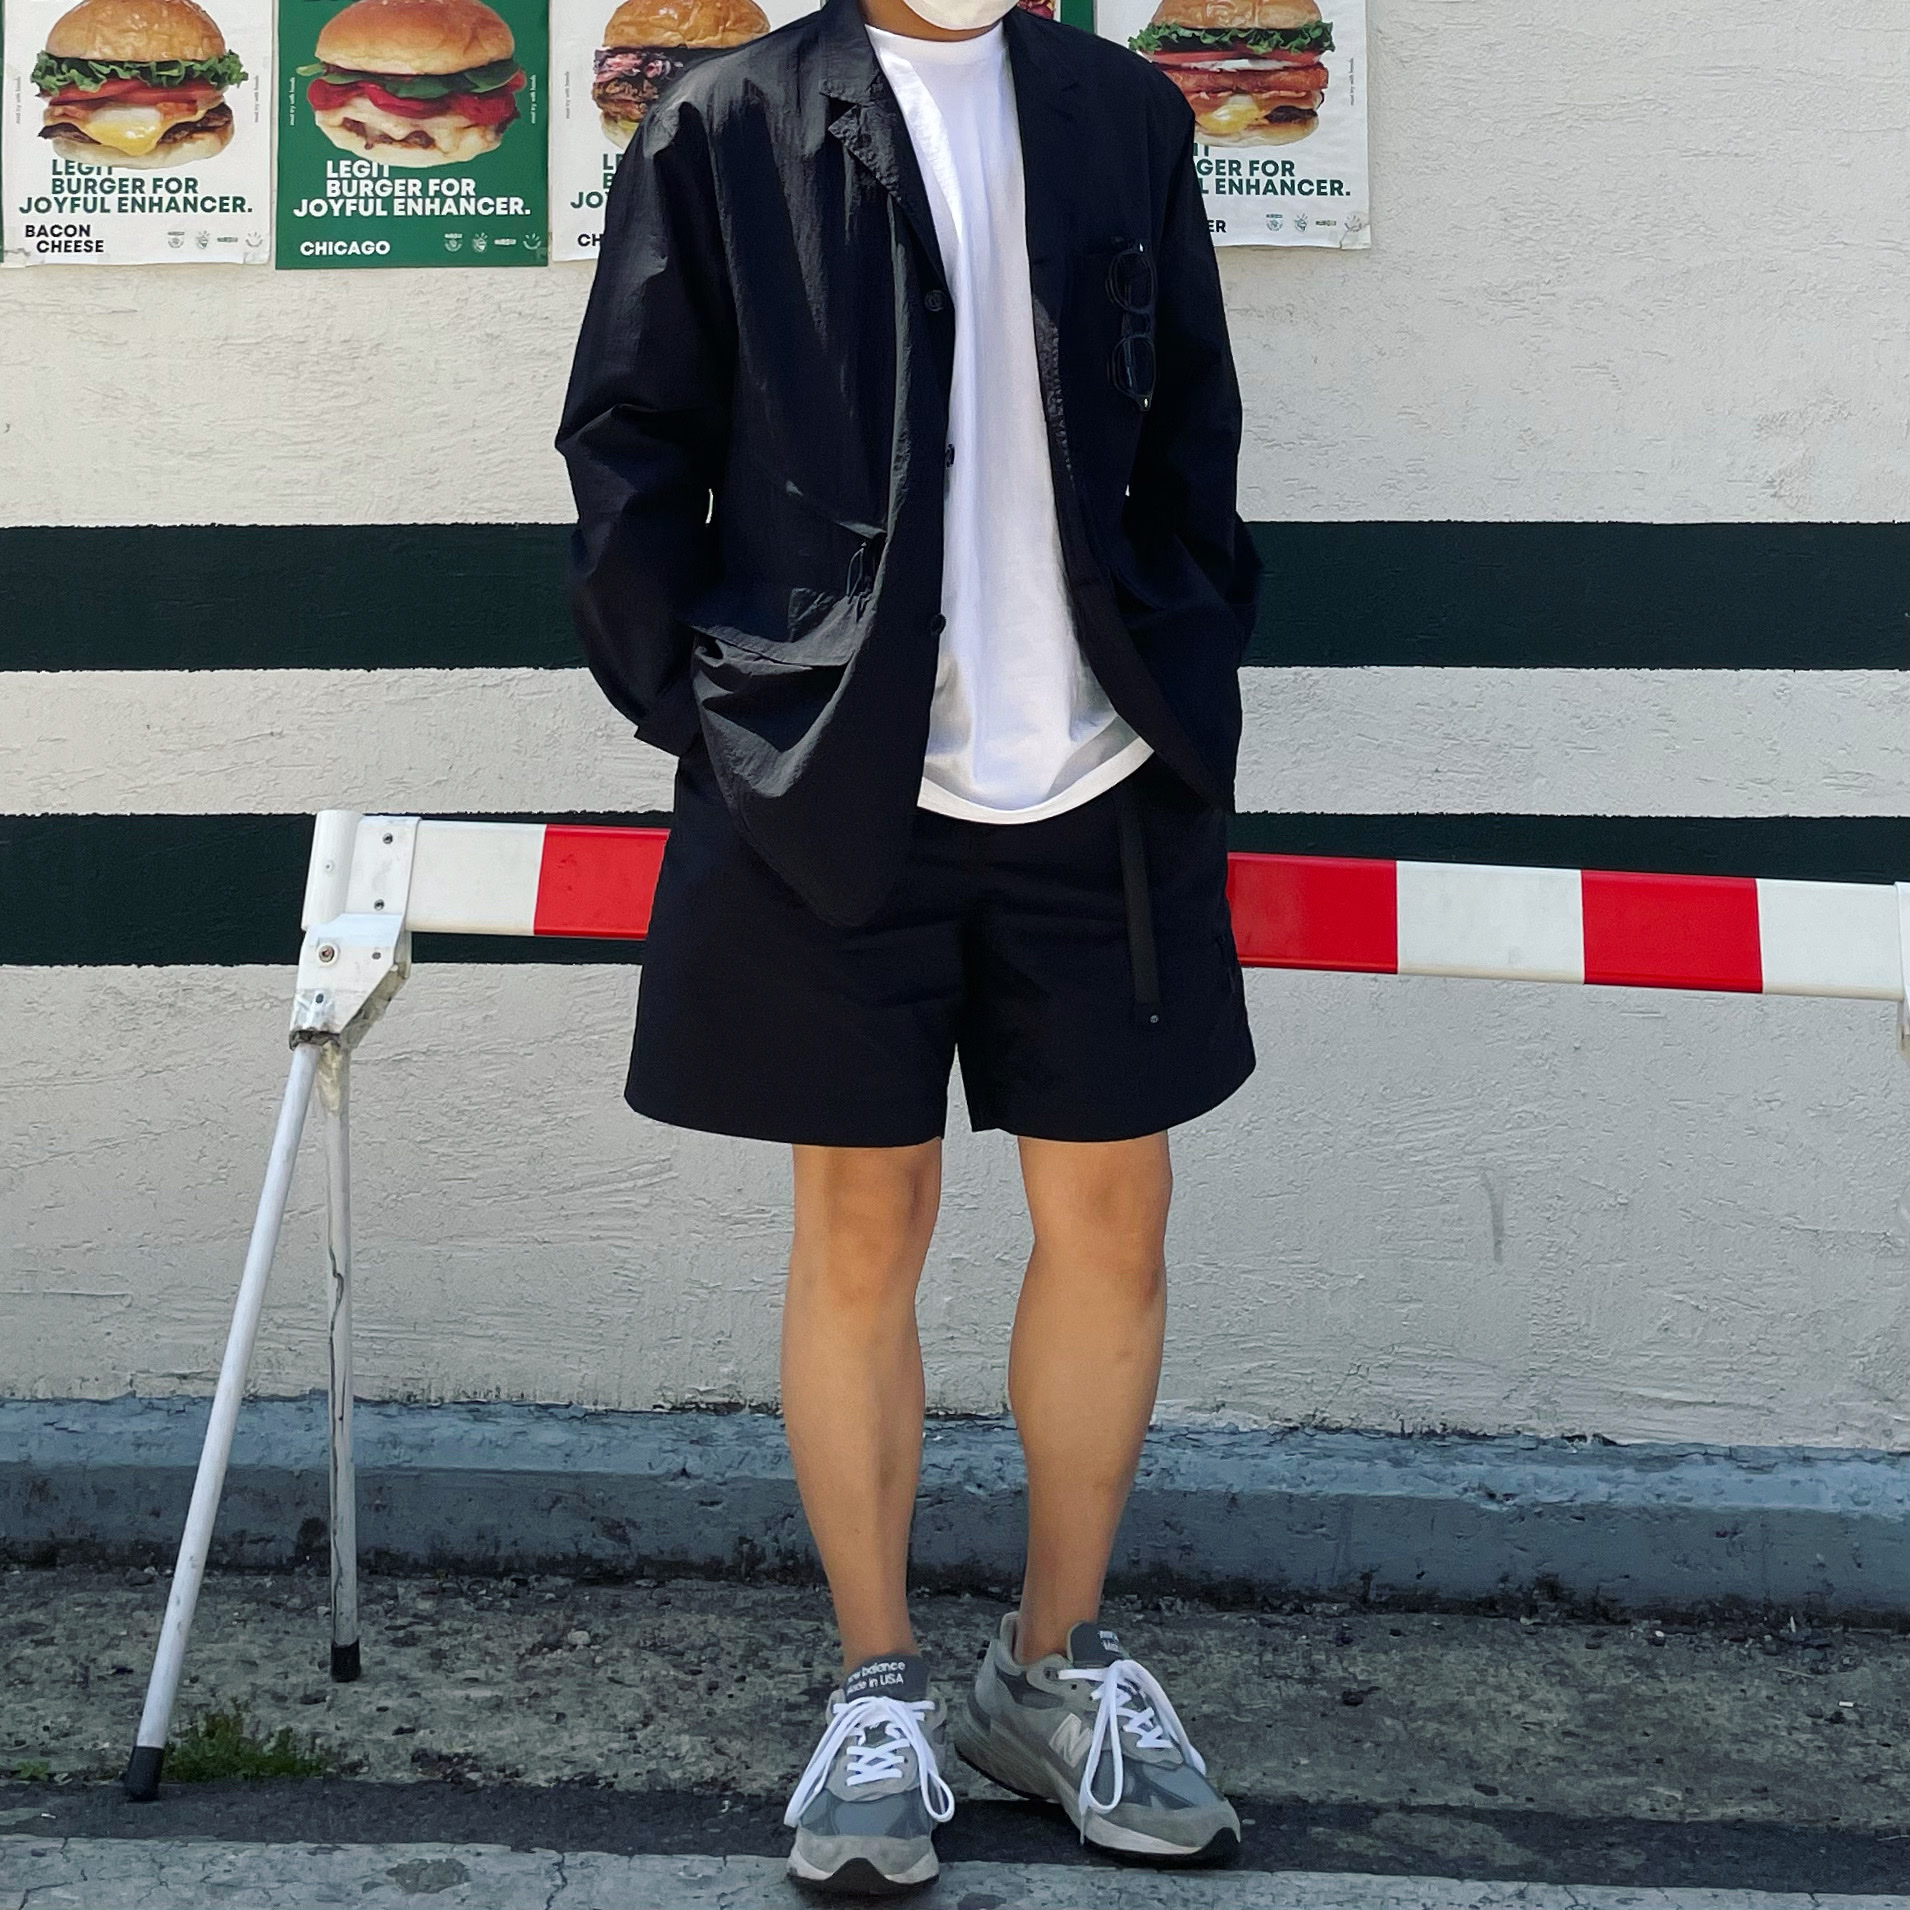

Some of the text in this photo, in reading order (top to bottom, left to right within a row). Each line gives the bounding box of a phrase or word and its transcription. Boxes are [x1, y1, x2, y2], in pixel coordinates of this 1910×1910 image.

[1248, 160, 1295, 177] FOR
[52, 177, 199, 195] BURGER FOR
[326, 178, 476, 198] BURGER FOR
[1215, 178, 1351, 197] ENHANCER.
[19, 196, 253, 214] JOYFUL ENHANCER.
[293, 197, 531, 217] JOYFUL ENHANCER.
[25, 224, 91, 238] BACON
[36, 239, 104, 253] CHEESE
[300, 240, 390, 256] CHICAGO
[880, 1673, 904, 1686] USA
